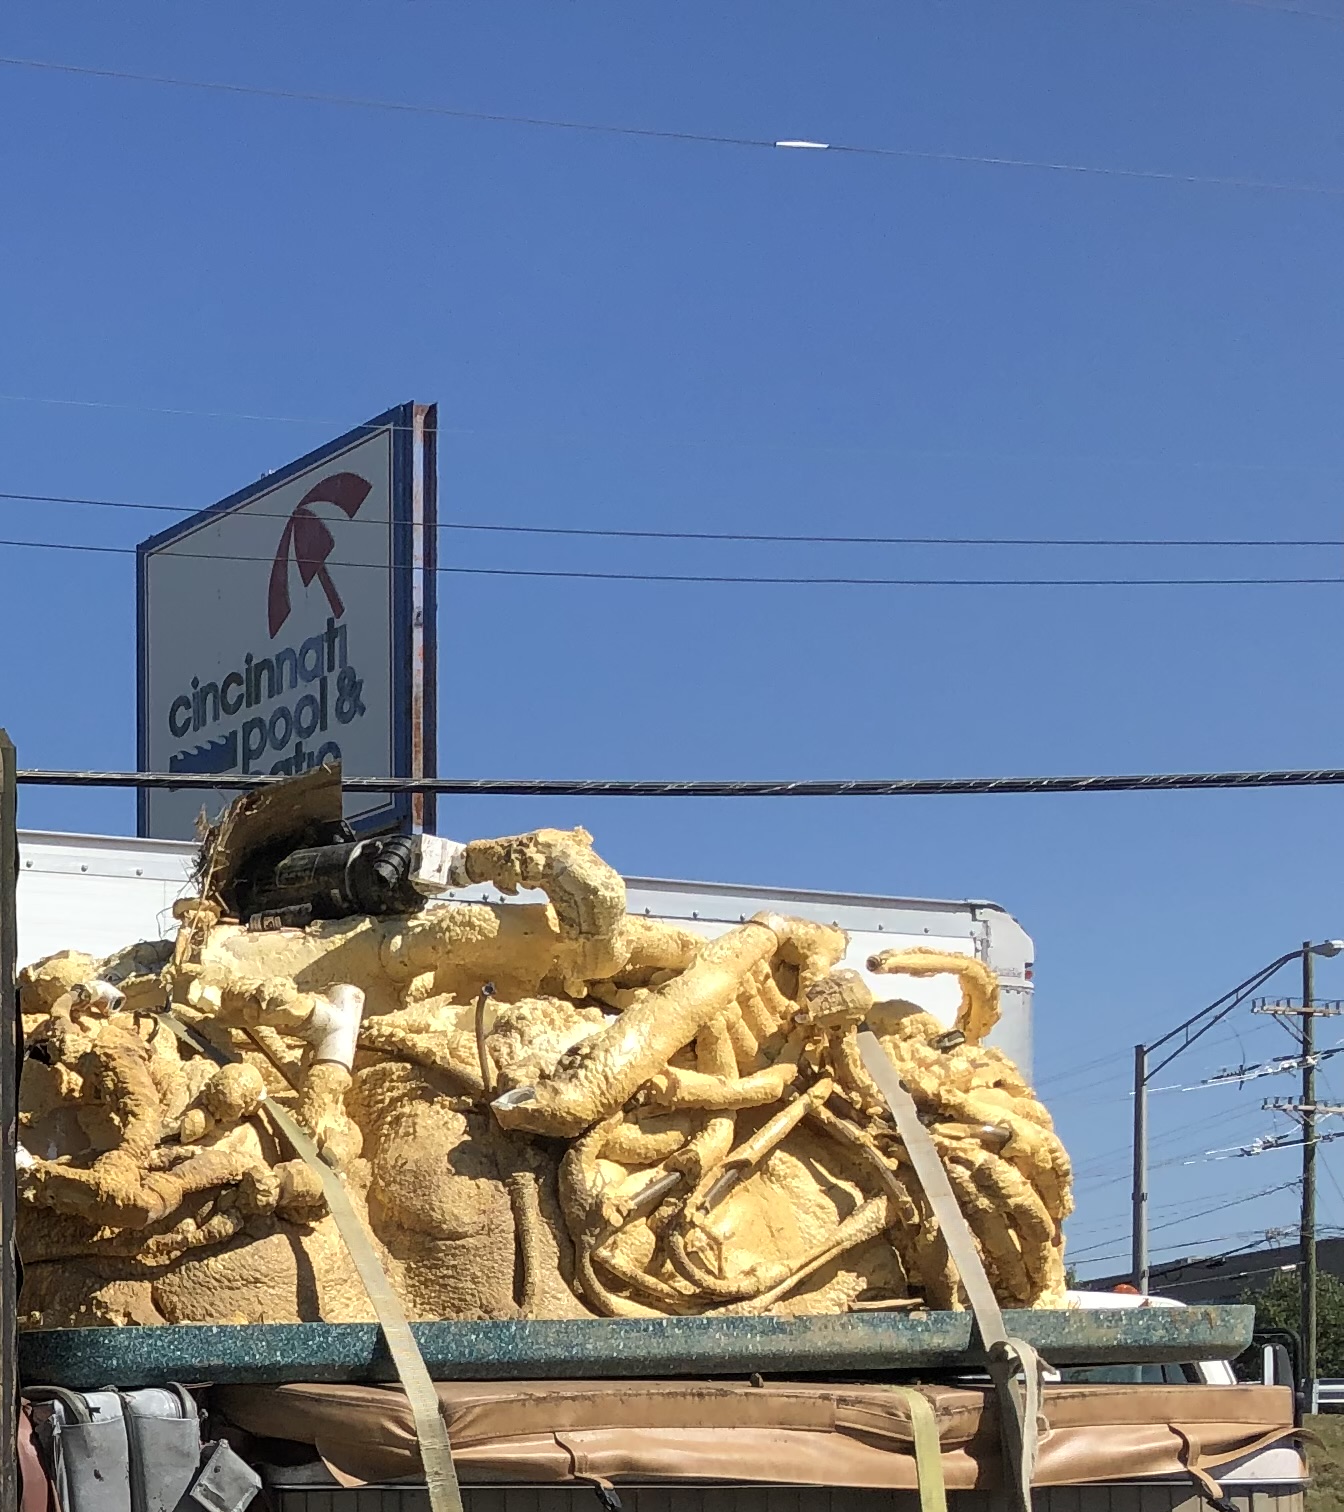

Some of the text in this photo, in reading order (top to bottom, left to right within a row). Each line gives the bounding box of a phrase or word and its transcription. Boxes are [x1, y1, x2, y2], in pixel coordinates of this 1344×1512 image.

[169, 617, 348, 738] cincinnati
[241, 666, 367, 775] pool &
[249, 740, 343, 776] ato
